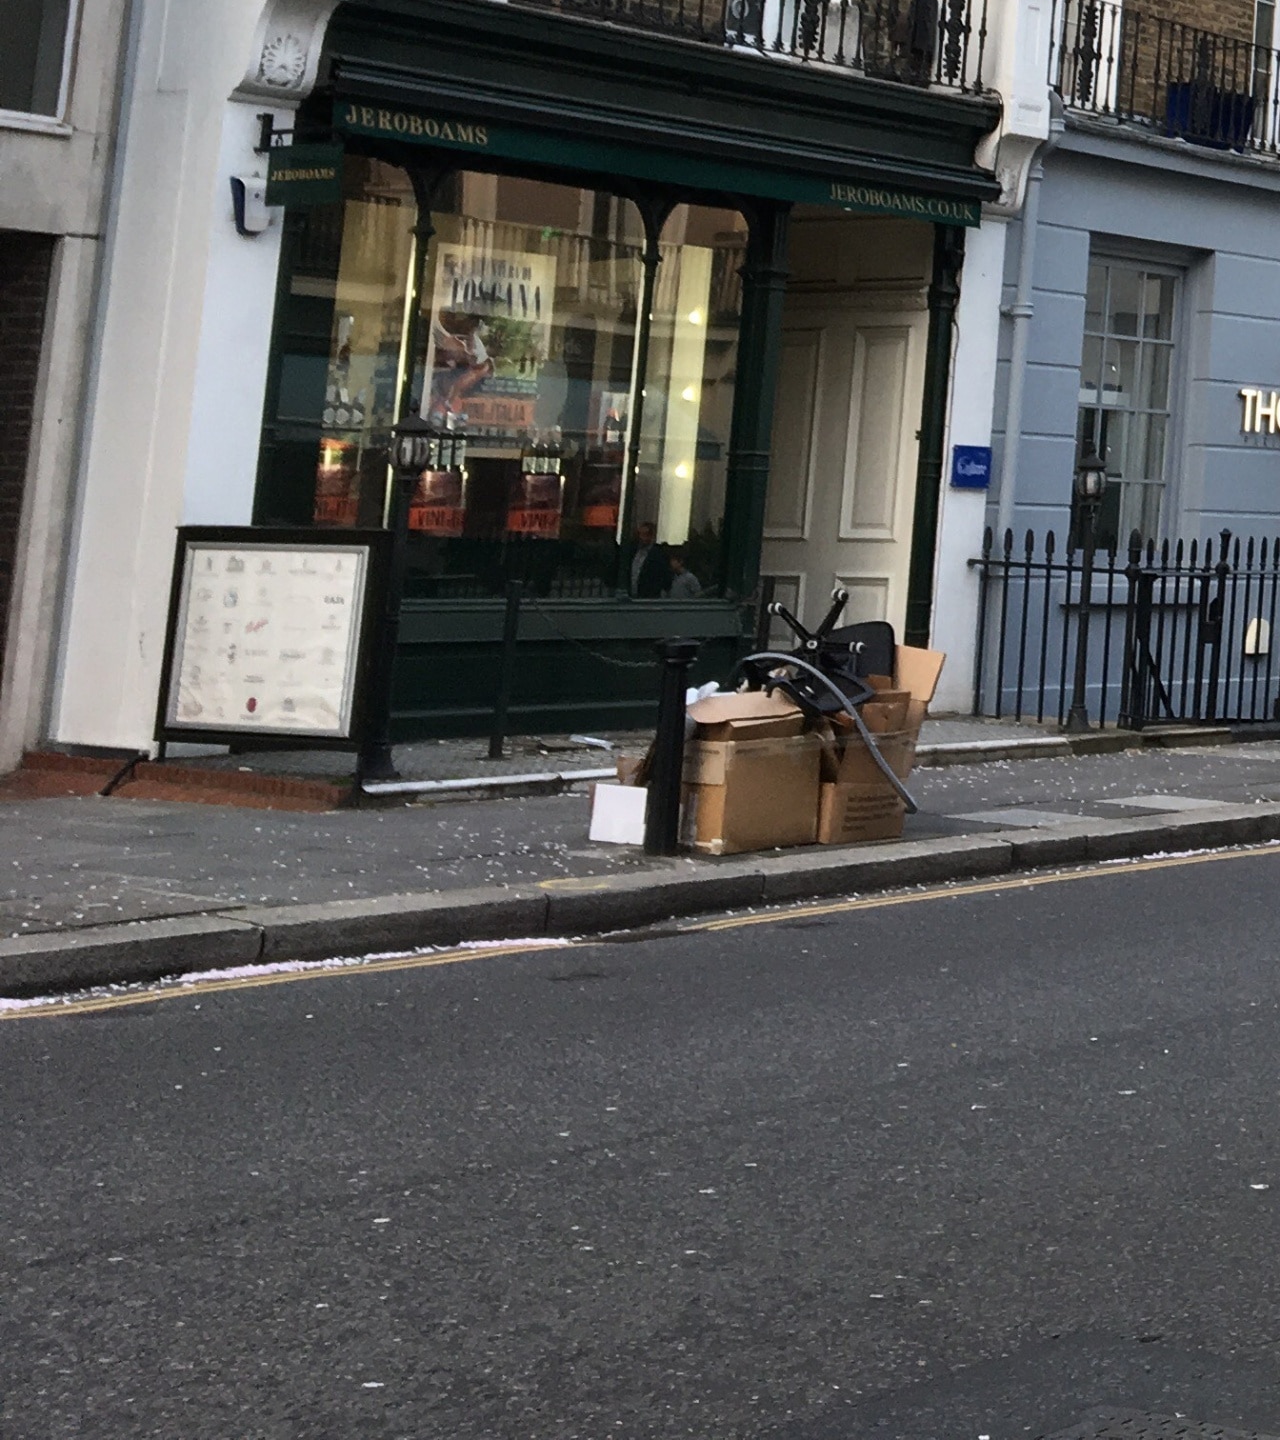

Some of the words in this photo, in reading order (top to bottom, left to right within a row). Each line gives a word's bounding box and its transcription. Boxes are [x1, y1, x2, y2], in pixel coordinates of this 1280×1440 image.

[346, 104, 488, 145] JEROBOAMS
[271, 167, 335, 181] JEROBOAMS
[830, 183, 975, 221] JEROBOAMS.CO.UK
